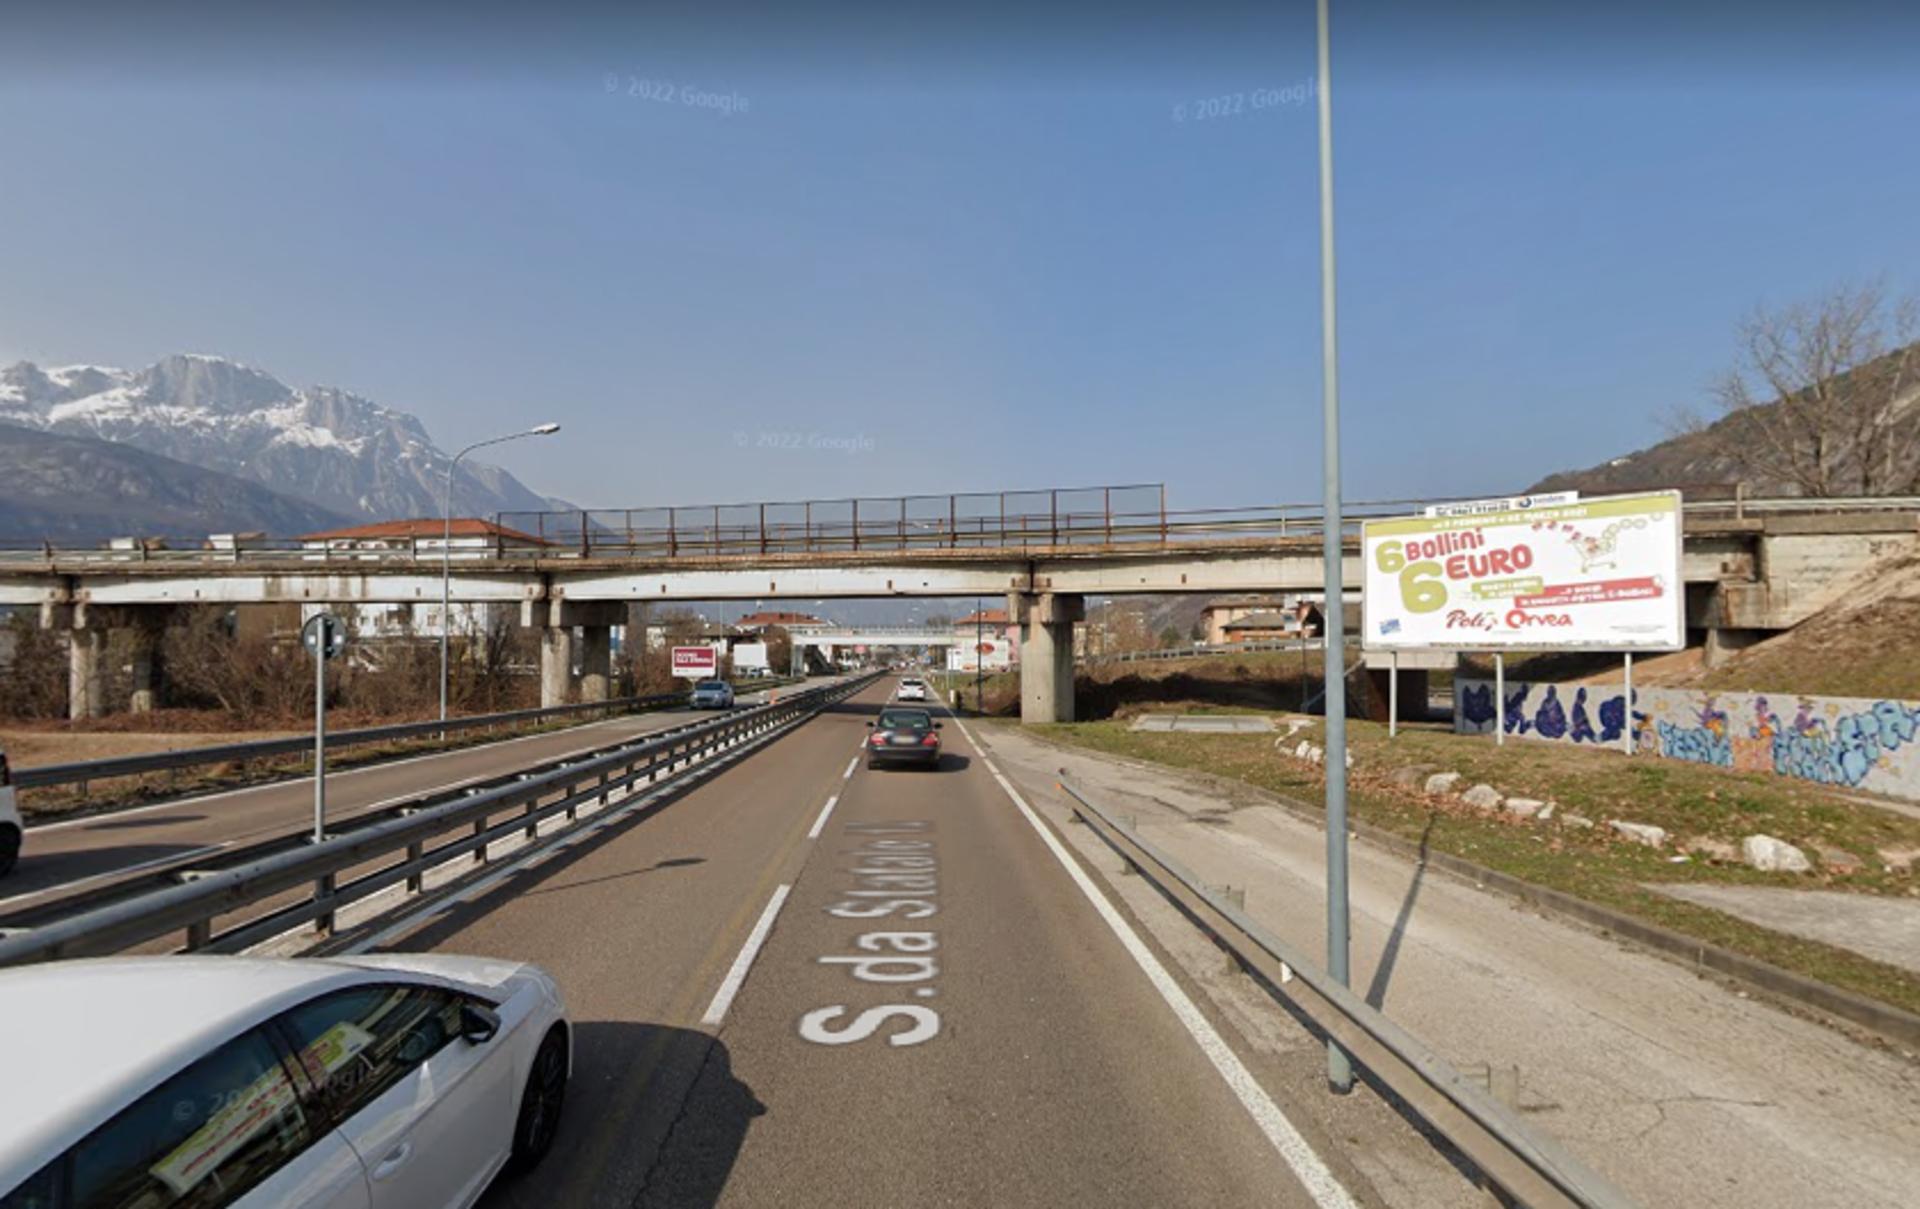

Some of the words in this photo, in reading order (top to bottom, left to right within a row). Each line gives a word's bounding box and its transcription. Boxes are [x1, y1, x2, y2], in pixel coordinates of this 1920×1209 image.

[1375, 540, 1405, 574] 6
[1399, 560, 1448, 614] 6
[1445, 544, 1533, 580] EURO
[1505, 609, 1573, 629] Orvea
